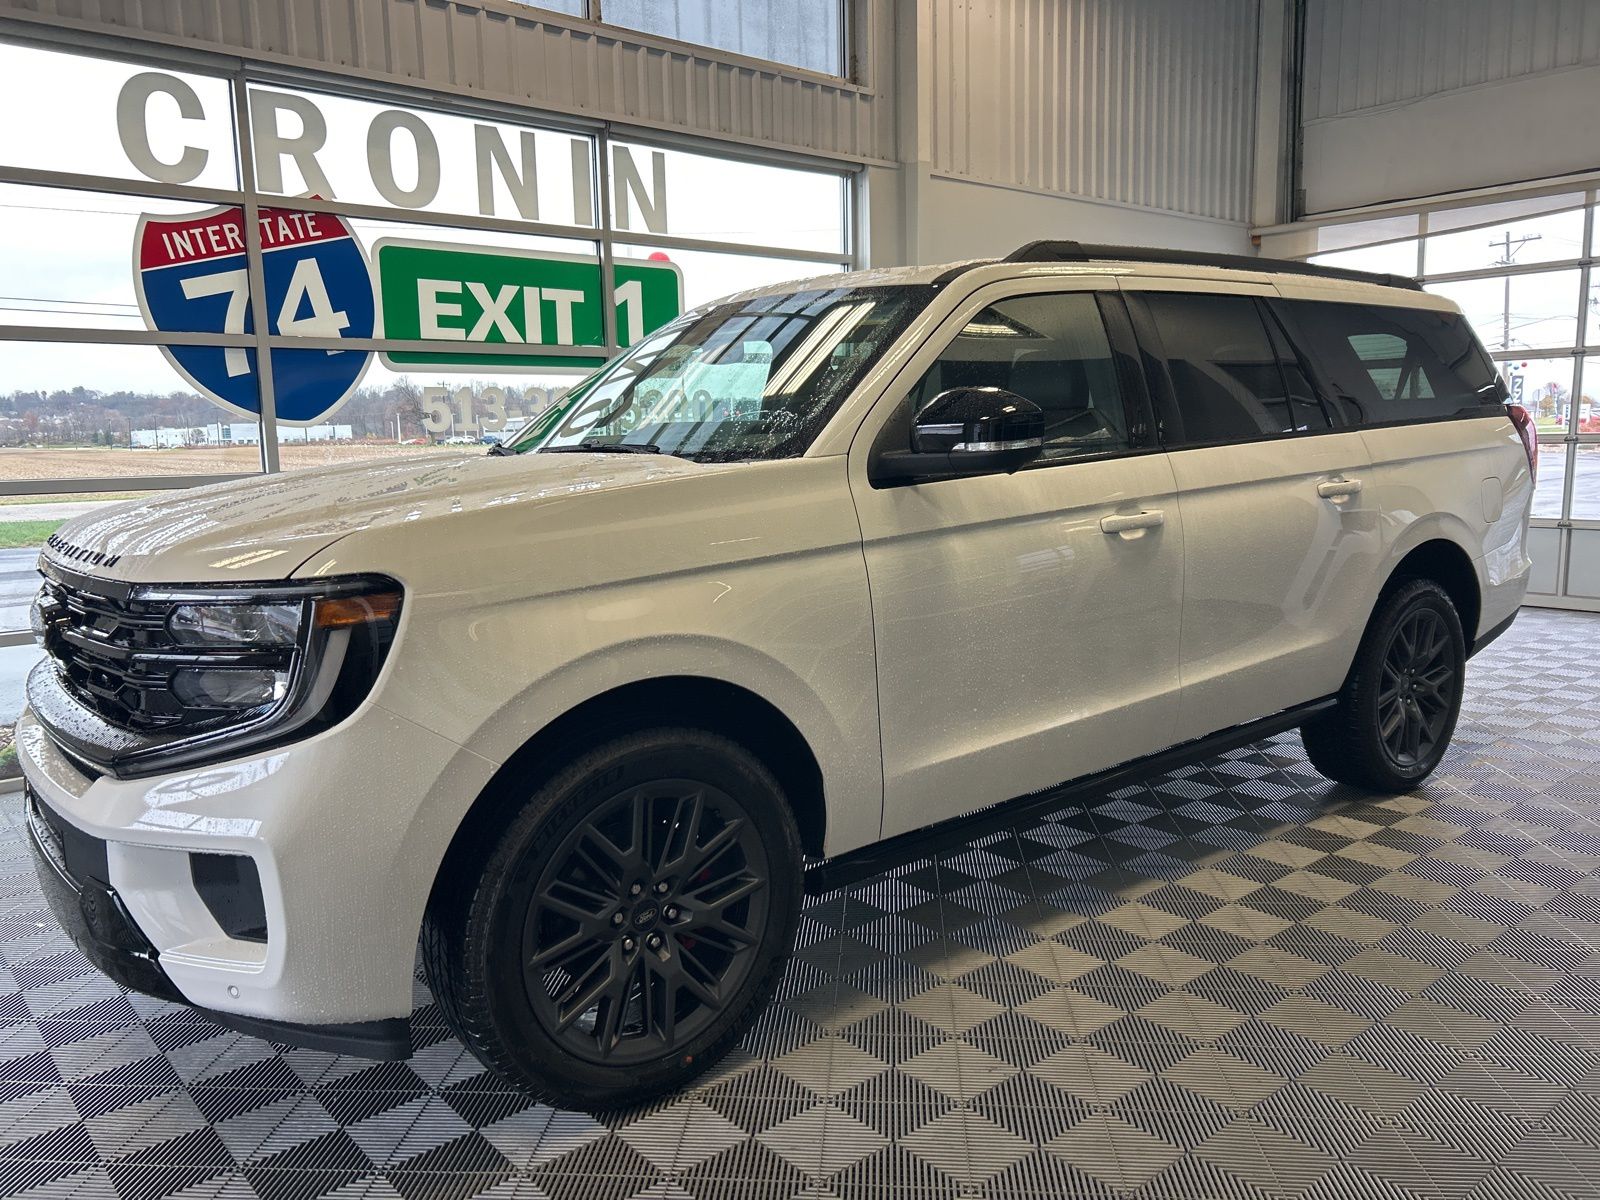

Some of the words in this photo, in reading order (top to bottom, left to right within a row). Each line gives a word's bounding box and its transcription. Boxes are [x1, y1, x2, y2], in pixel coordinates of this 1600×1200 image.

[116, 71, 668, 235] CRONIN
[161, 212, 323, 260] INTERTATE
[179, 258, 350, 378] 74
[416, 277, 585, 346] EXIT
[613, 280, 644, 349] 1
